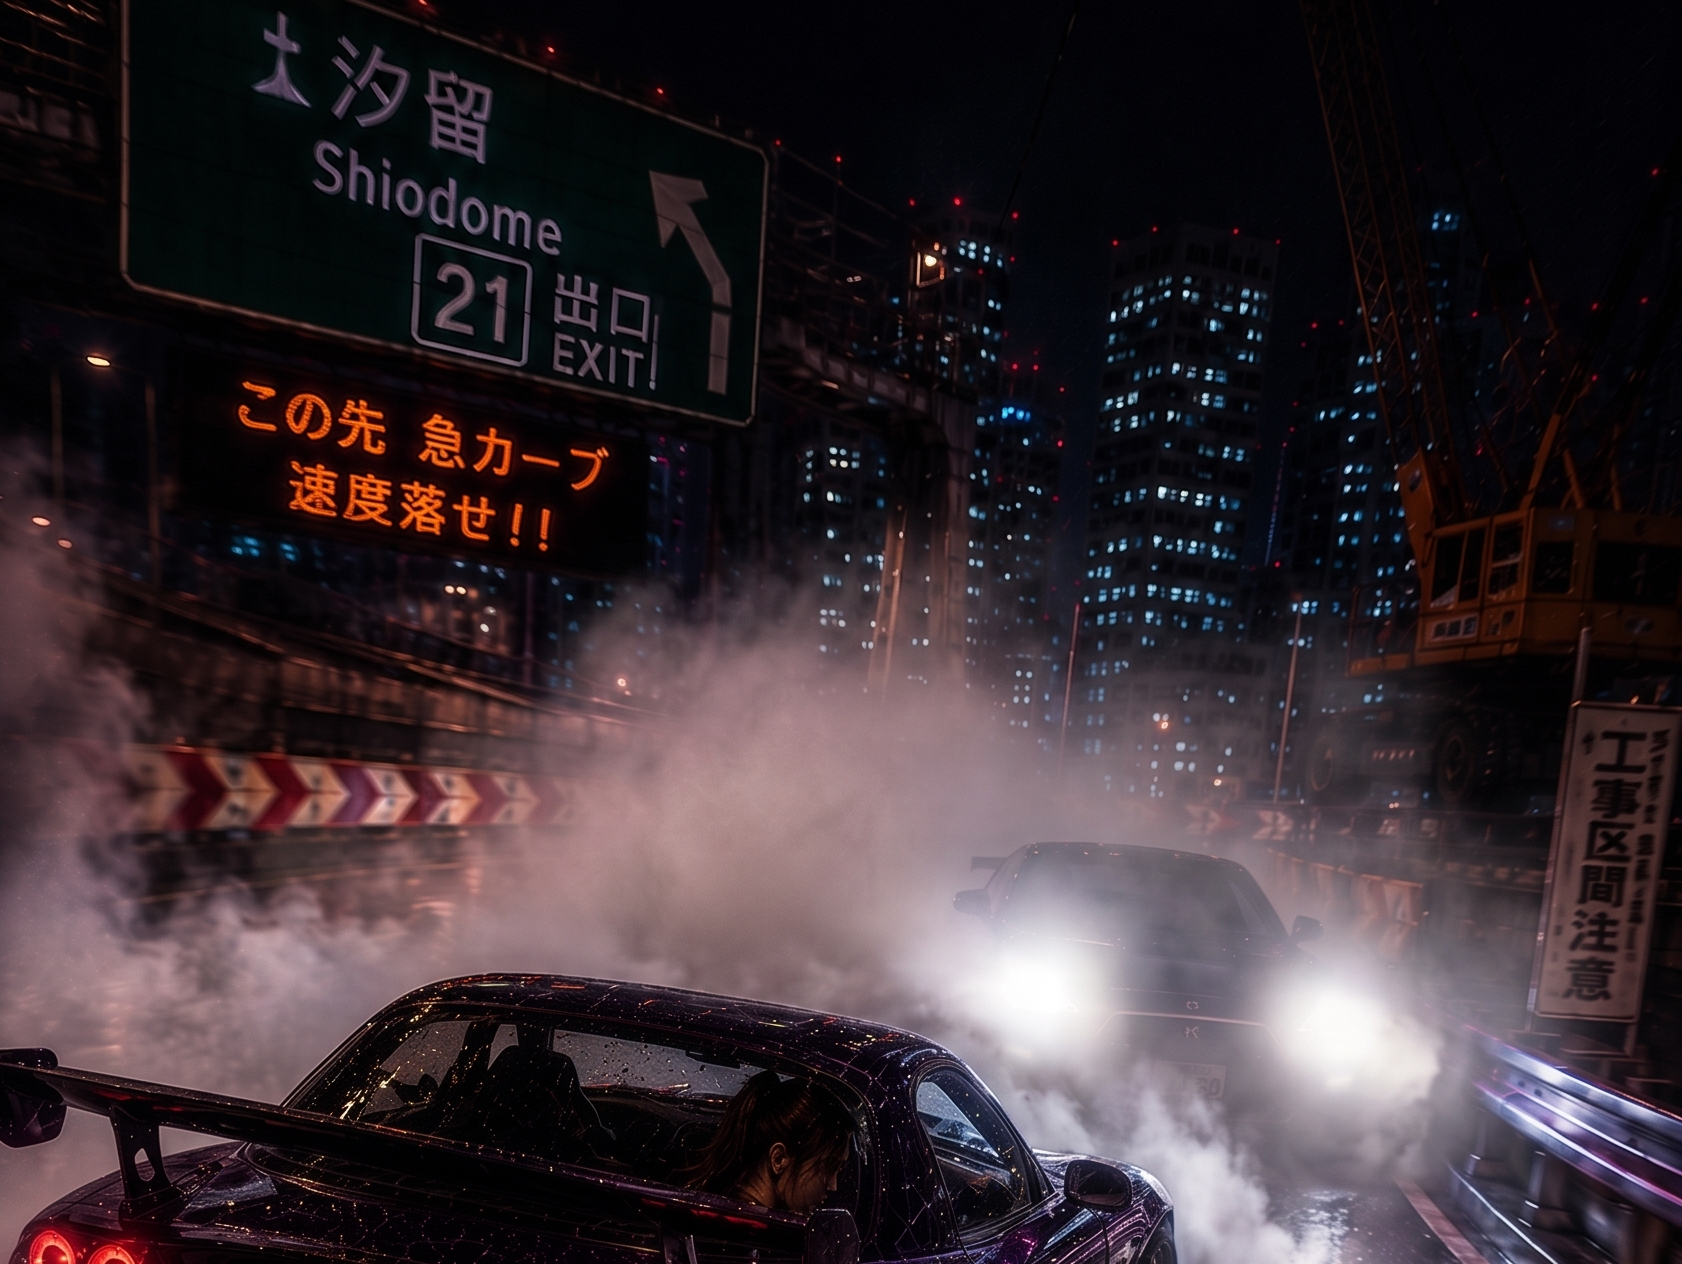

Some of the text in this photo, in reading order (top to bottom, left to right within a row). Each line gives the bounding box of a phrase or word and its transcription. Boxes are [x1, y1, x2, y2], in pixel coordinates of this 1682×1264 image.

[331, 35, 493, 165] 汐留
[312, 139, 563, 256] Shiodome
[434, 262, 509, 344] 21
[553, 272, 652, 344] 出口
[238, 380, 610, 491] この先 急カーブ
[1561, 730, 1648, 1002] 工事区間注意
